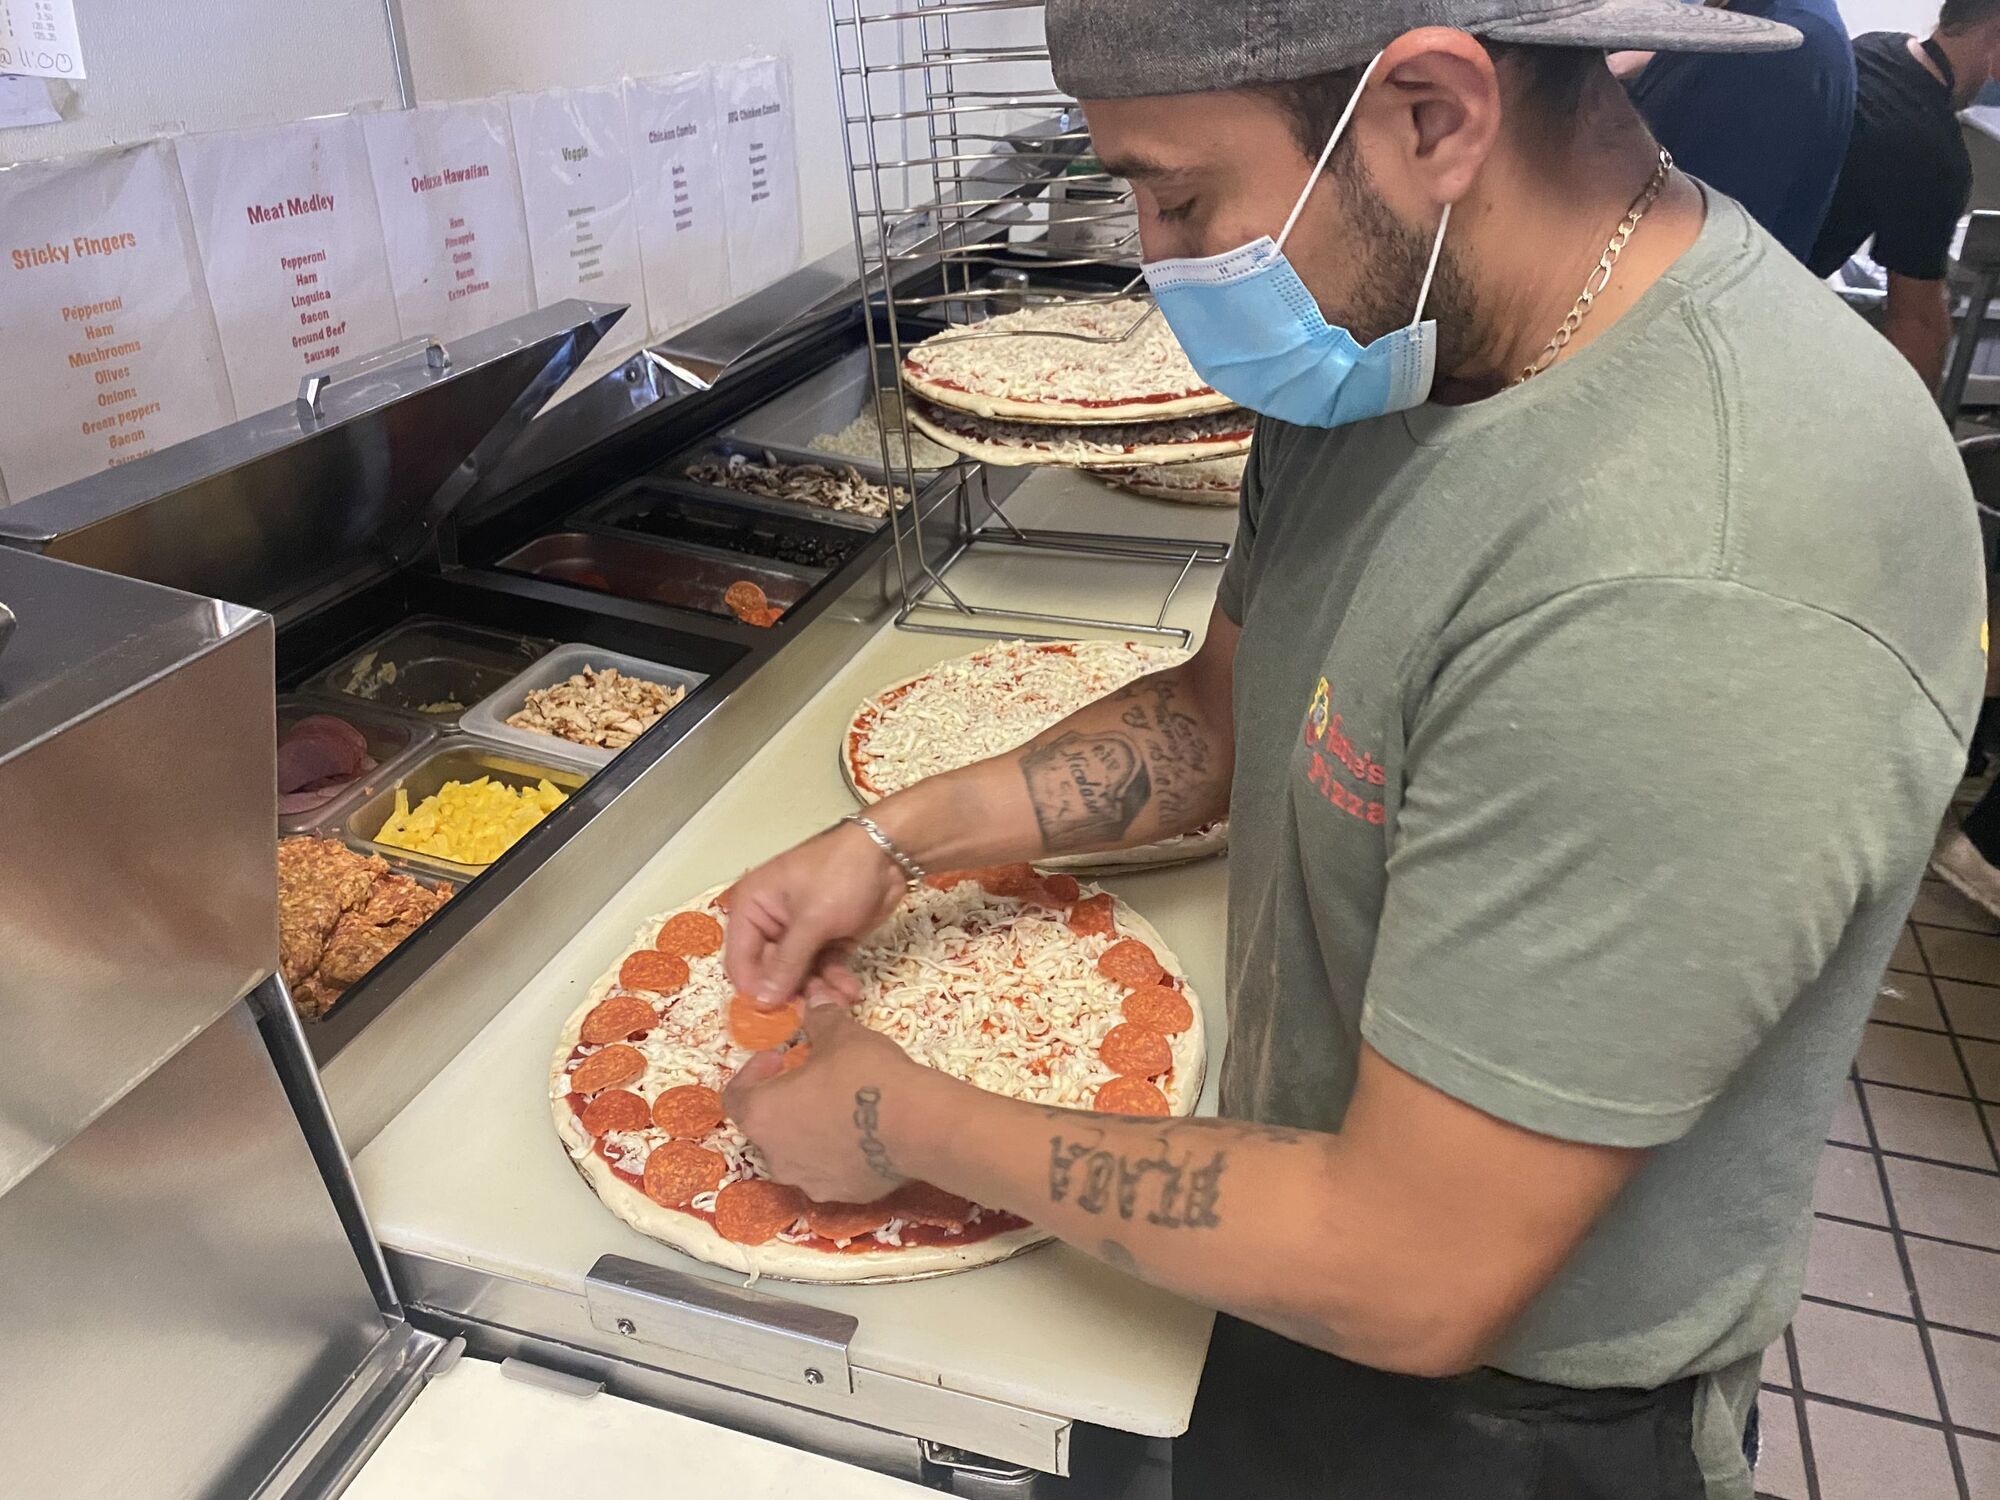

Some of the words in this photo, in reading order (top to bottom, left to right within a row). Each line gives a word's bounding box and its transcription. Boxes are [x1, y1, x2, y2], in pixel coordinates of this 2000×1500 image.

[562, 145, 588, 162] Veggie
[411, 174, 442, 193] Deluxe
[443, 164, 489, 185] Hawaiian
[247, 202, 285, 225] Meat
[287, 193, 334, 220] Medley
[11, 243, 71, 270] Sticky
[73, 232, 136, 258] Fingers
[281, 249, 326, 270] Pepperoni
[296, 273, 317, 286] Ham
[61, 296, 123, 321] Pepperoni
[300, 310, 329, 325] Bacon
[85, 324, 114, 340] Ham
[292, 328, 324, 348] Ground
[325, 321, 346, 338] Beef
[68, 340, 141, 368] Mushrooms
[304, 345, 340, 364] Sausage
[95, 366, 130, 385] Olives
[97, 387, 137, 407] Onions
[82, 414, 116, 435] Green
[118, 401, 161, 426] peppers
[109, 430, 145, 449] Bacon
